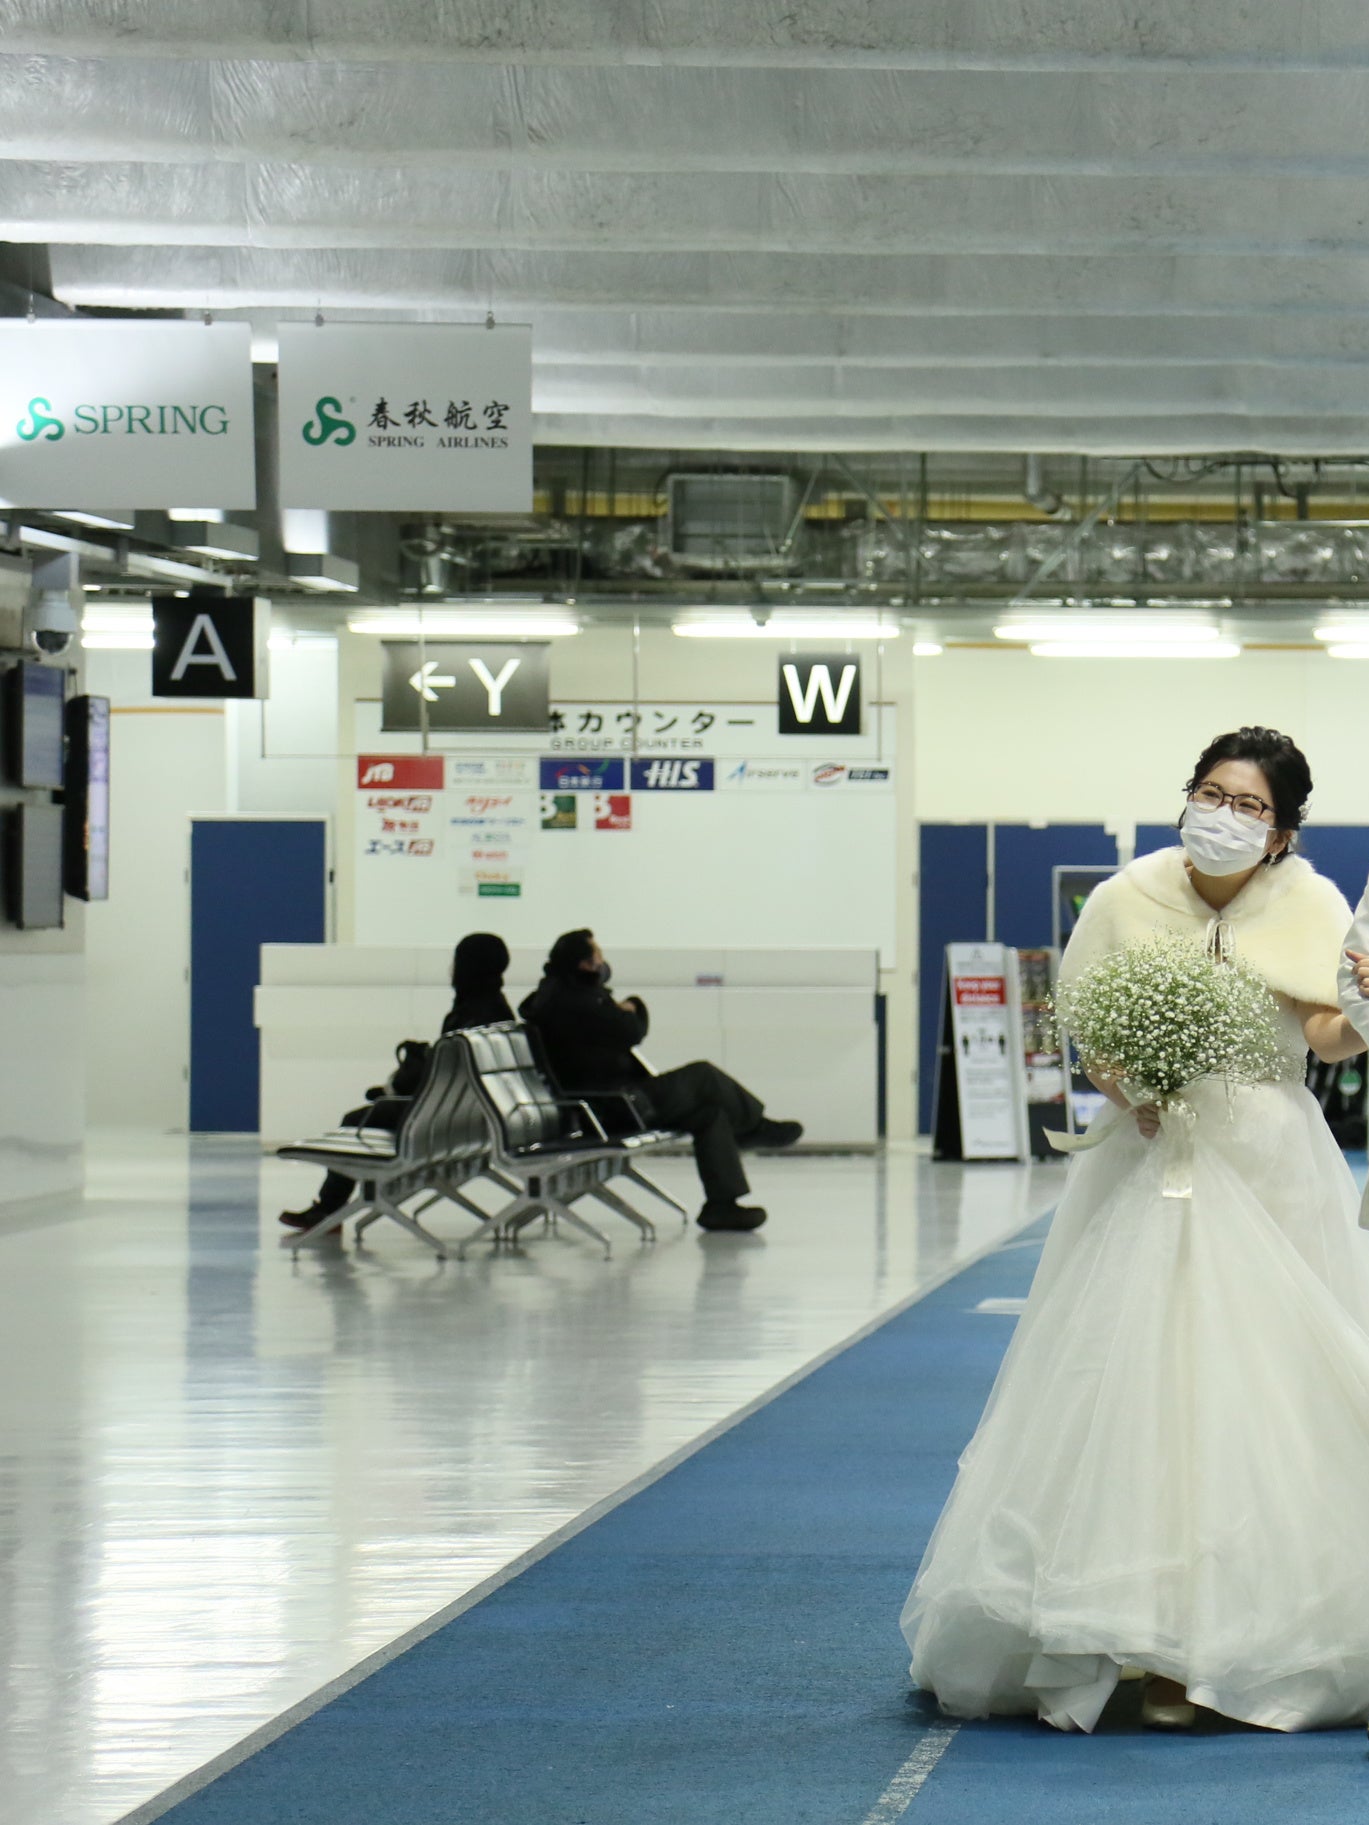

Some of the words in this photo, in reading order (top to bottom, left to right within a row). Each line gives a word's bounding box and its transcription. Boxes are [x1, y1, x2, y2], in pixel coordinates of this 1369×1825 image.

[74, 404, 230, 436] SPRING
[367, 397, 510, 430] 春秋航空
[367, 435, 424, 448] SPRING
[436, 435, 508, 448] AIRLINES
[169, 613, 237, 681] A
[468, 657, 521, 716] Y
[782, 664, 857, 724] W
